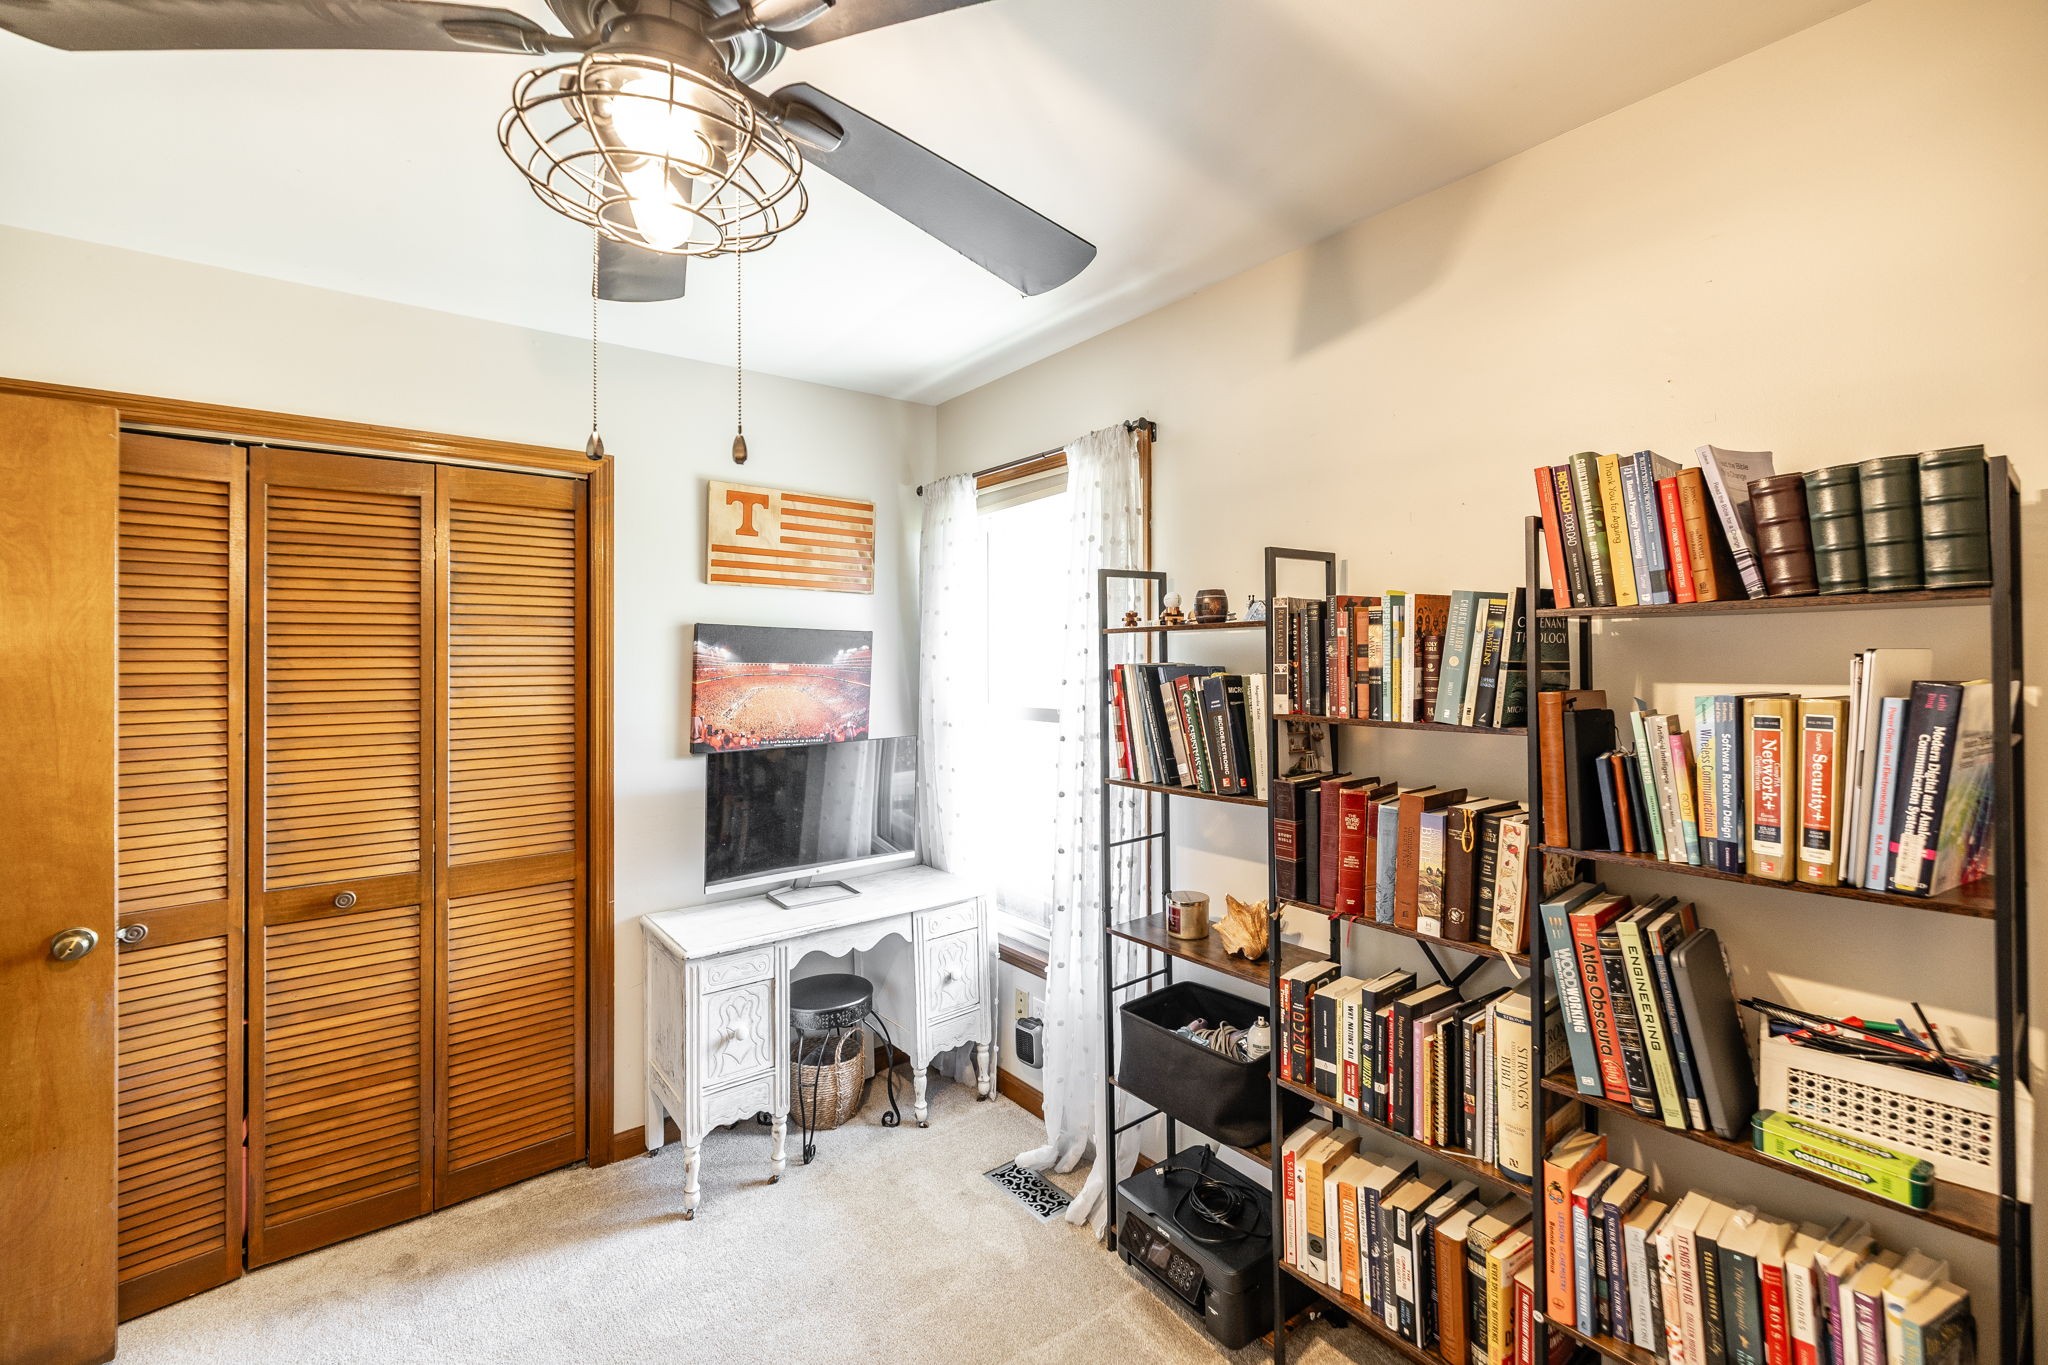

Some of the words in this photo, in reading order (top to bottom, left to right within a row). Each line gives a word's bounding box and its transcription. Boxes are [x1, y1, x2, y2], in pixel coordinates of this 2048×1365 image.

[1556, 471, 1569, 493] RICH
[1605, 462, 1615, 485] Thank
[1560, 492, 1573, 513] DAD
[1576, 458, 1591, 502] COUNTDOWN
[1585, 515, 1596, 537] LADEN
[1609, 487, 1617, 501] You
[1626, 480, 1636, 501] Rental
[726, 490, 749, 536] T
[1563, 514, 1575, 531] POOR
[1611, 503, 1619, 514] for
[1628, 501, 1640, 529] Property
[1713, 481, 1722, 495] Read
[1721, 504, 1730, 517] Bible
[1730, 529, 1742, 549] Change
[1566, 530, 1578, 546] DAD
[1611, 515, 1623, 544] Arguing
[1632, 529, 1644, 559] Investing
[1589, 541, 1599, 559] CHRIS
[1592, 560, 1603, 586] WALLACE
[1677, 563, 1686, 588] INVESTING
[1457, 599, 1469, 625] CHURCH
[1383, 596, 1391, 682] DISPENSATIONALISM
[1454, 627, 1466, 653] HISTORY
[1483, 622, 1496, 665] INDWELLING
[1491, 638, 1501, 652] THE
[1888, 707, 1897, 727] Power
[1937, 693, 1949, 711] Lathi
[1188, 724, 1202, 766] CHRISTMAS
[1217, 715, 1230, 775] MICROELECTRONIC
[1657, 725, 1666, 749] Artificial
[1700, 729, 1713, 763] Wireless
[1721, 733, 1731, 771] Software
[1885, 728, 1895, 753] Circuits
[1929, 725, 1947, 762] Modern
[1659, 750, 1671, 784] Intelligence
[1761, 738, 1777, 809] Network+
[1909, 733, 1931, 805] Communication
[1922, 762, 1941, 793] Digital
[1702, 765, 1717, 832] Communications
[1722, 774, 1732, 808] Receiver
[1808, 754, 1827, 821] Security+
[1878, 767, 1891, 825] Electromechanics
[1921, 794, 1936, 813] and
[1721, 810, 1732, 838] Design
[1405, 827, 1415, 868] Chronological
[1421, 827, 1432, 863] BIBLE
[1580, 941, 1601, 982] Atlas
[1555, 958, 1564, 979] COMPLETE
[1560, 980, 1569, 1006] STEP-BY-STEP
[1559, 947, 1587, 1034] WOODWORKING
[1656, 959, 1669, 983] Building
[1663, 988, 1676, 1017] Affordable
[1628, 944, 1661, 1052] ENGINEERING
[1363, 1008, 1371, 1021] JIM
[1588, 984, 1616, 1056] Obscura
[1363, 1021, 1372, 1041] KWIK
[1362, 1054, 1373, 1088] LIMITLESS
[1501, 1056, 1511, 1090] BIBLE
[1518, 1046, 1529, 1109] STRONG'S
[1341, 1199, 1357, 1244] COLLAPSE
[1557, 1211, 1565, 1243] LESSONS
[1575, 1207, 1586, 1247] NOVEMBER
[1608, 1217, 1617, 1248] NICHOLAS
[1678, 1234, 1688, 1244] IT
[1549, 1247, 1557, 1273] Garmus
[1559, 1252, 1568, 1292] CHEMISTRY
[1611, 1248, 1619, 1276] SPARKS
[1679, 1245, 1690, 1268] ENDS
[1703, 1250, 1717, 1285] COLLEEN
[1579, 1266, 1587, 1290] COLLEEN
[1681, 1269, 1693, 1293] WITH
[1734, 1267, 1744, 1281] The
[1478, 1287, 1486, 1308] The
[1614, 1291, 1622, 1318] CHOICE
[1683, 1294, 1694, 1305] US
[1707, 1286, 1720, 1320] HOOVER
[1733, 1283, 1749, 1331] Nightingale
[1793, 1274, 1807, 1331] BOUNDARIES
[1478, 1309, 1488, 1344] Arabs
[1521, 1303, 1531, 1337] INTELLIGENT
[1686, 1312, 1696, 1338] COLLEEN
[1769, 1304, 1784, 1339] BOYS
[1521, 1335, 1530, 1364] INVESTOR
